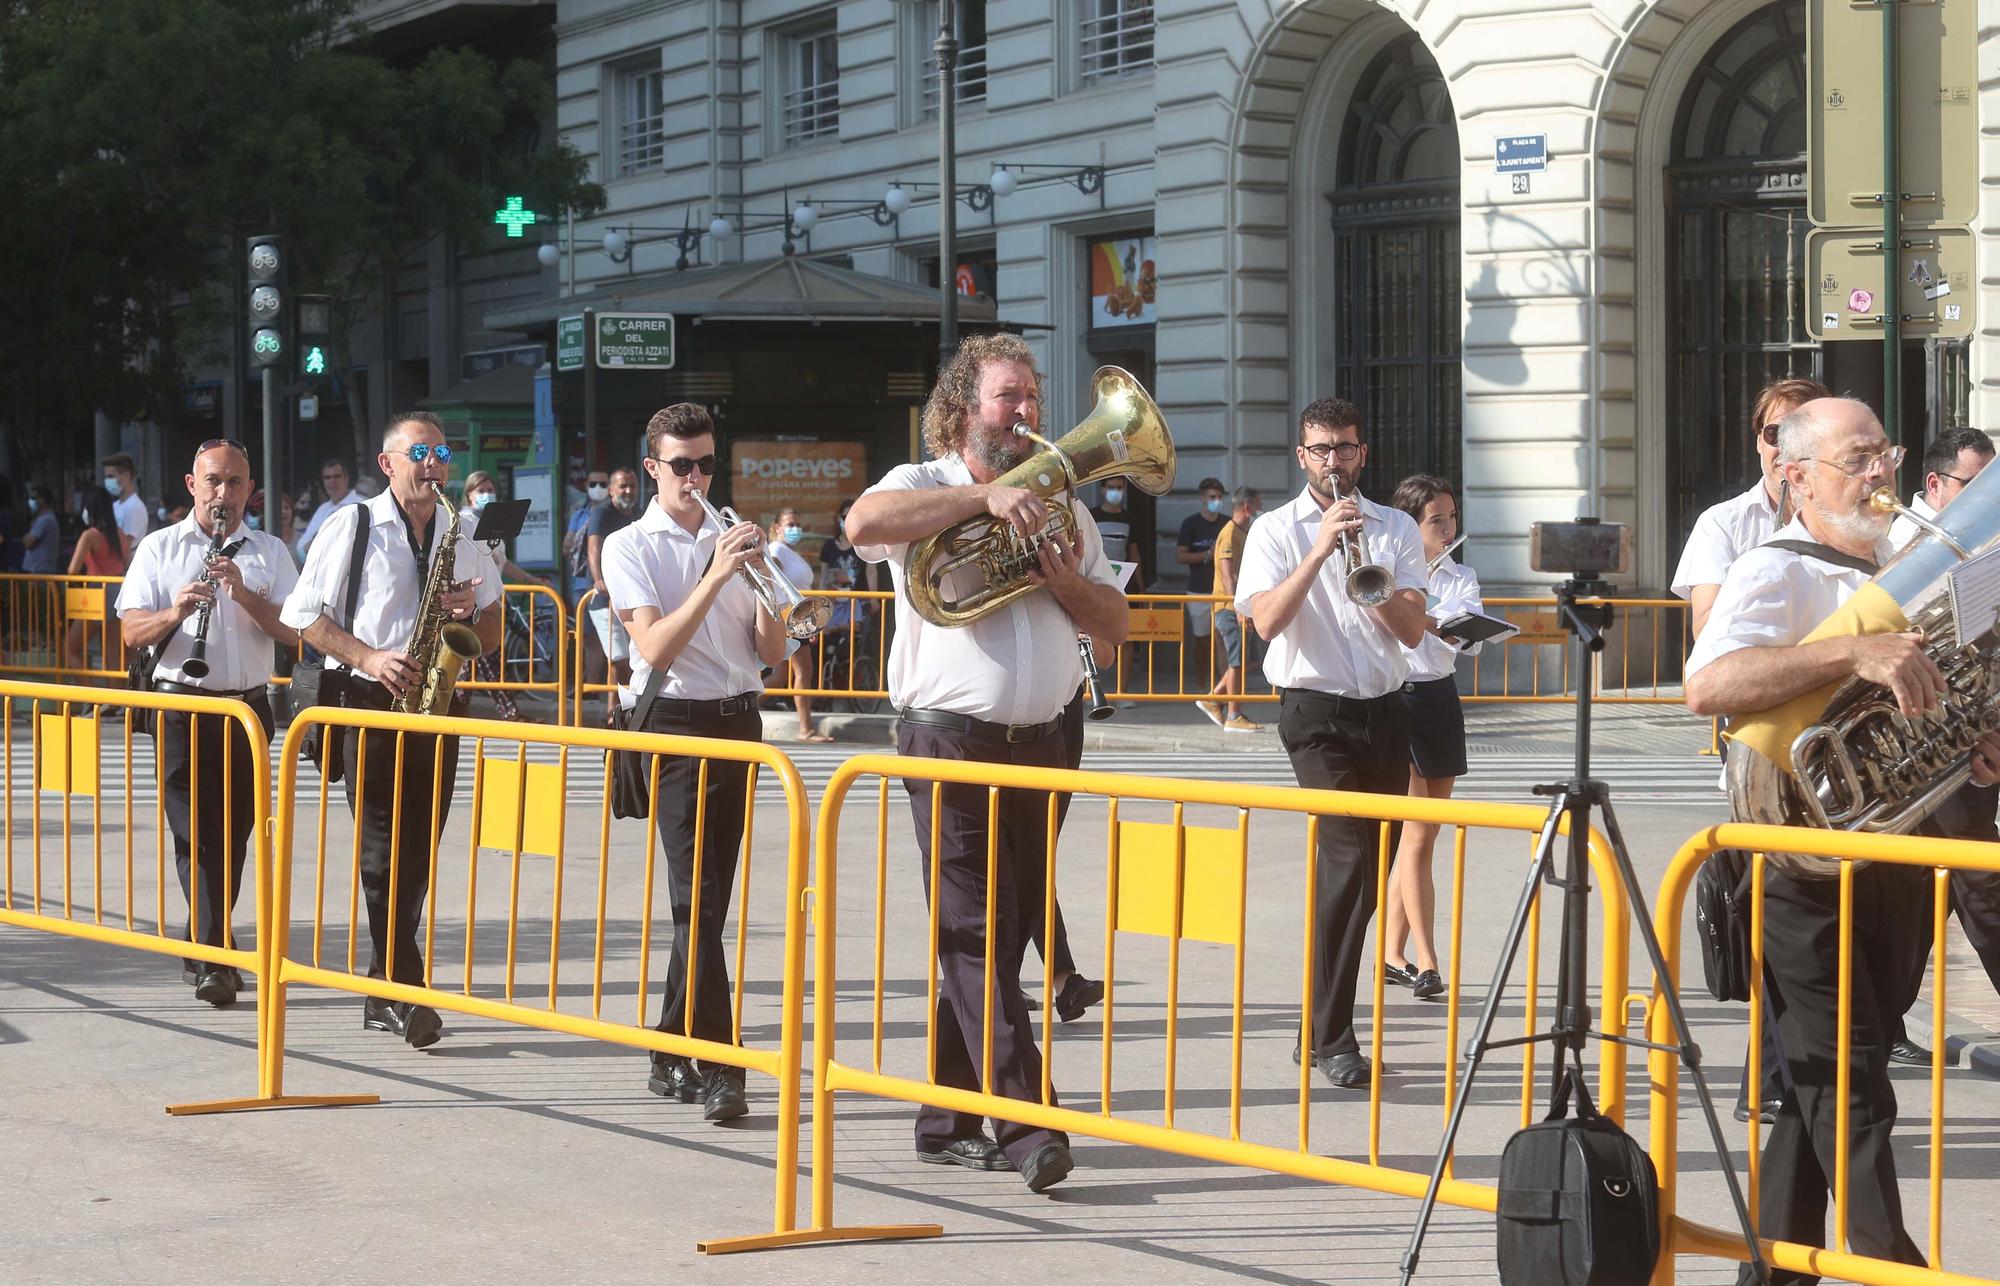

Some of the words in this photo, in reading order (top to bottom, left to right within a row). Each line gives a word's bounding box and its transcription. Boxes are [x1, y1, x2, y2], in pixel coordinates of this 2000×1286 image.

[1497, 156, 1545, 167] L'AJUNTAMENT
[618, 320, 666, 331] CARRER
[625, 333, 644, 343] DEL
[601, 345, 643, 356] PERIODISTA
[644, 346, 669, 356] AZZATI
